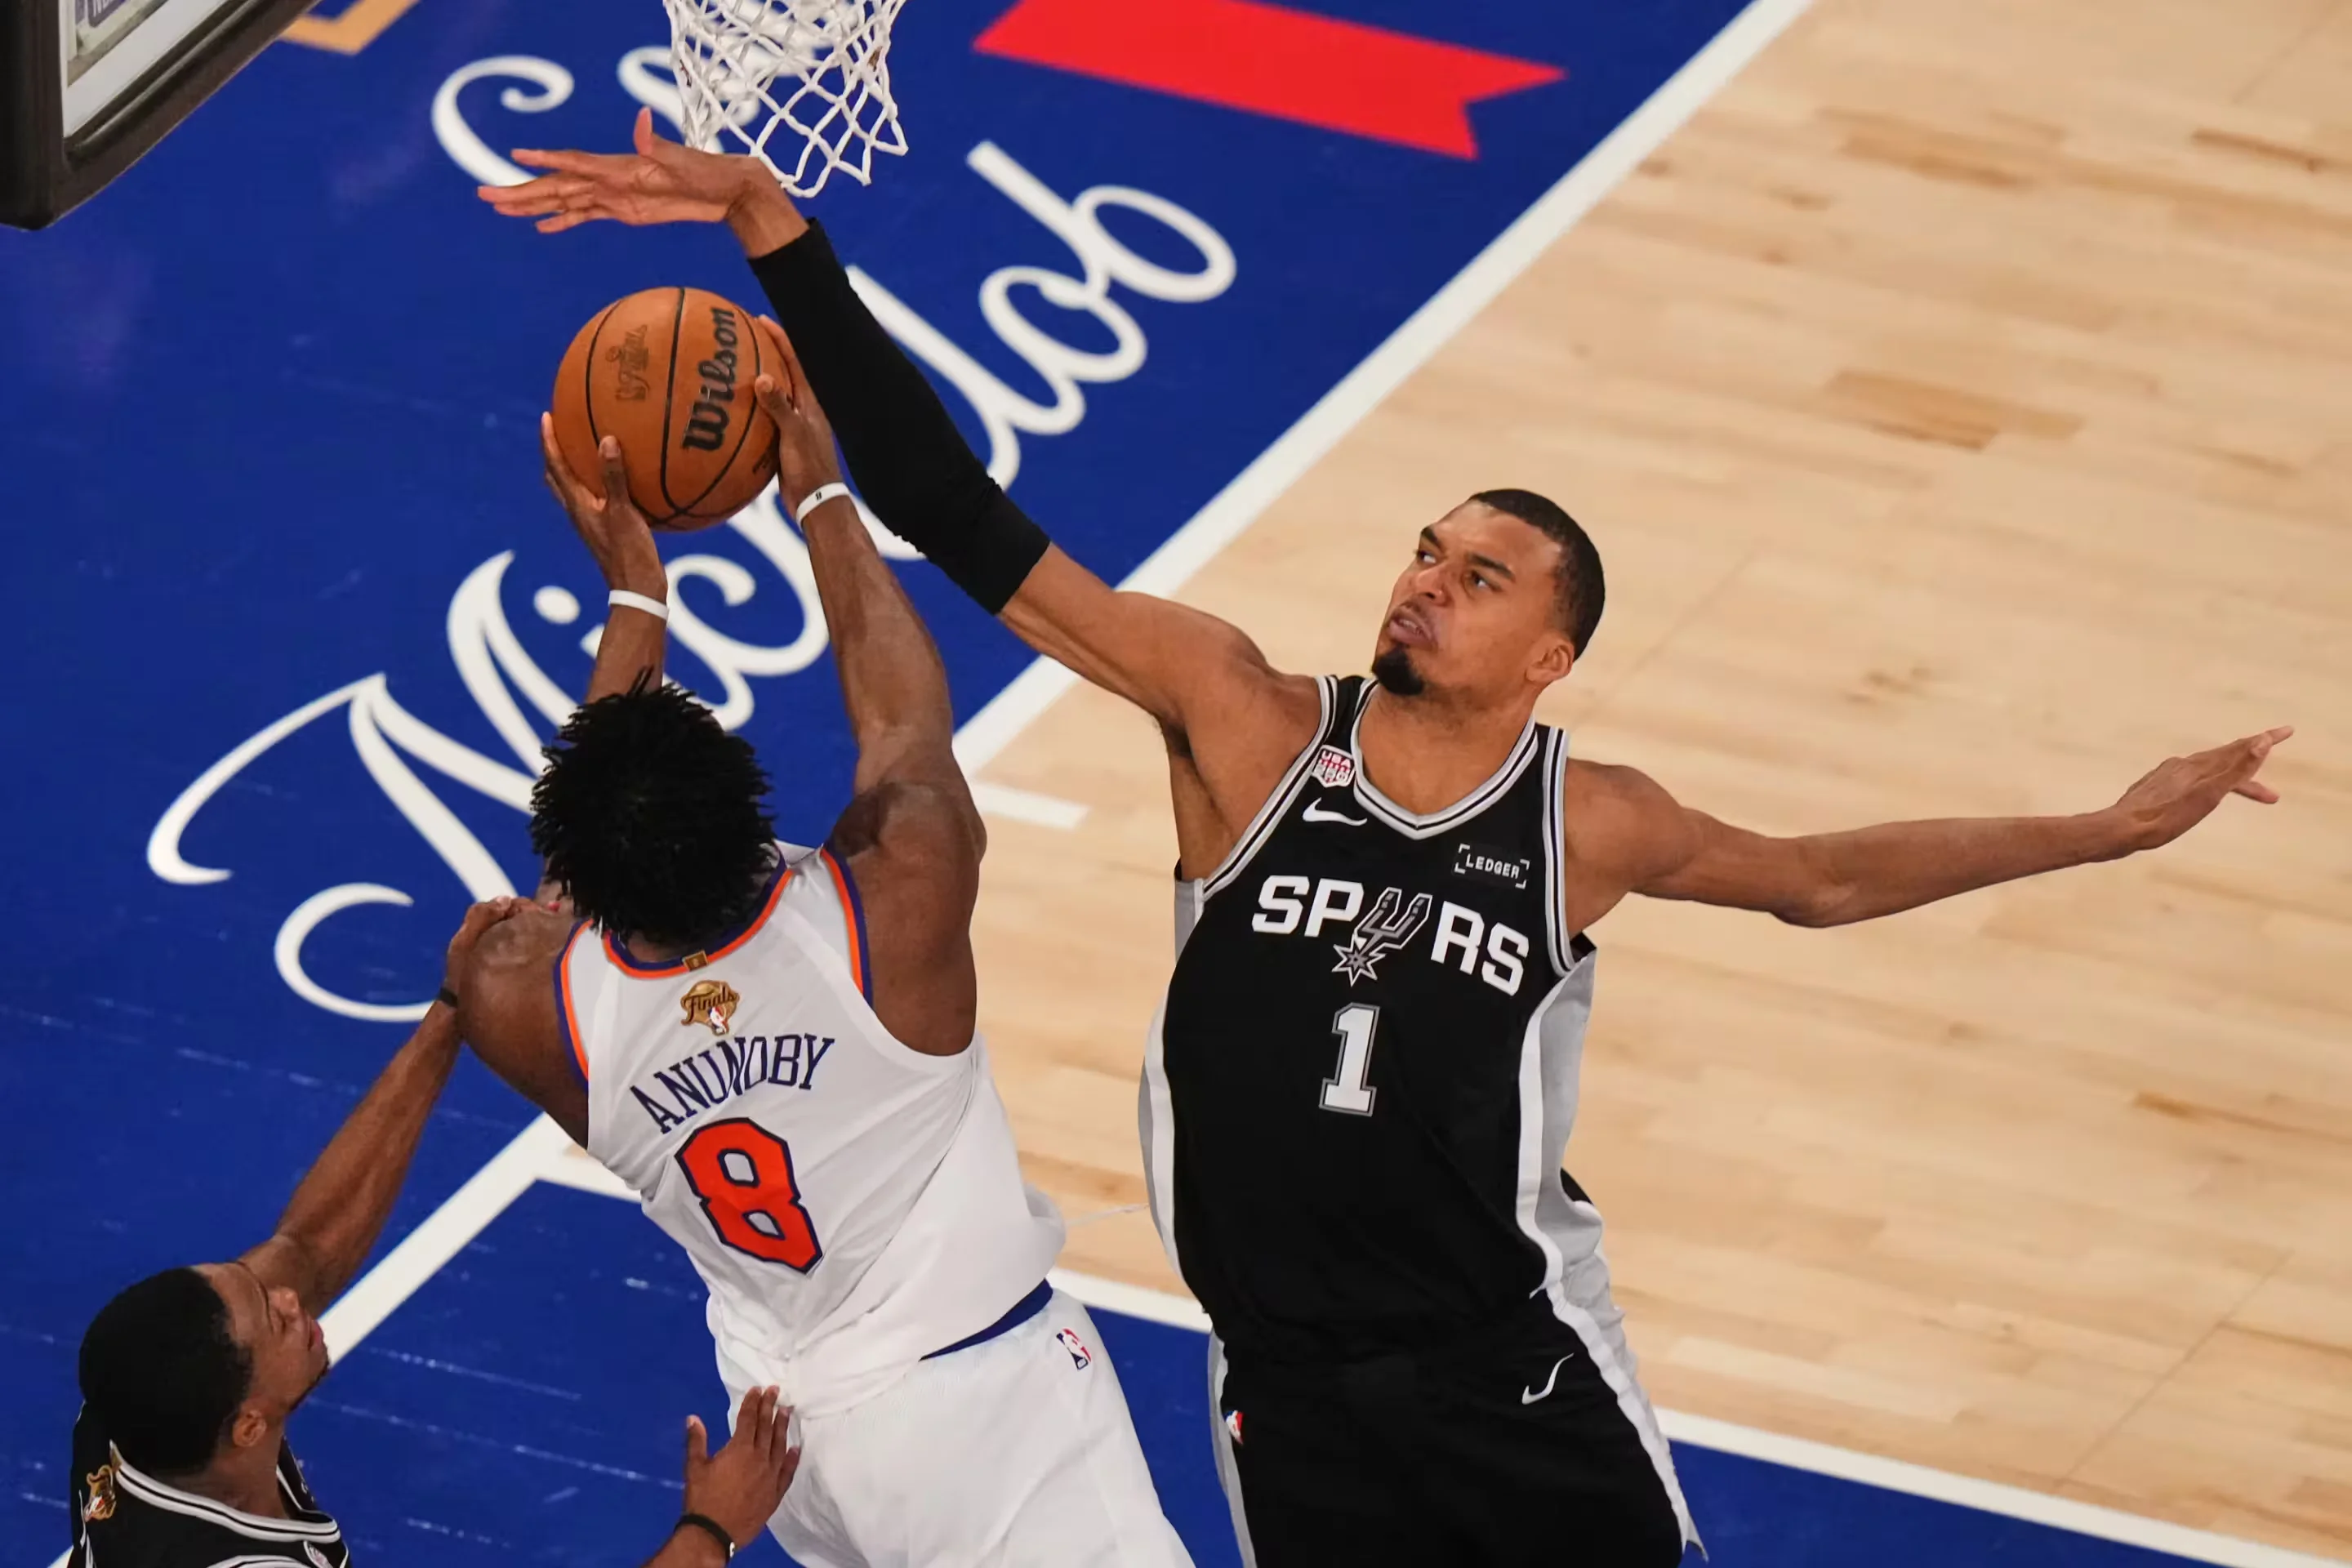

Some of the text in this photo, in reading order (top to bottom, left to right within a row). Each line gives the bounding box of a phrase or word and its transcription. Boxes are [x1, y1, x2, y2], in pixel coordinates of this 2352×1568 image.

[680, 306, 738, 452] Wilson
[1466, 853, 1520, 880] LEDGER
[1252, 875, 1530, 996] SPURS
[681, 986, 738, 1025] Finals
[1319, 1002, 1380, 1117] 1
[630, 1033, 835, 1134] ANUNOBY
[674, 1117, 822, 1274] 8
